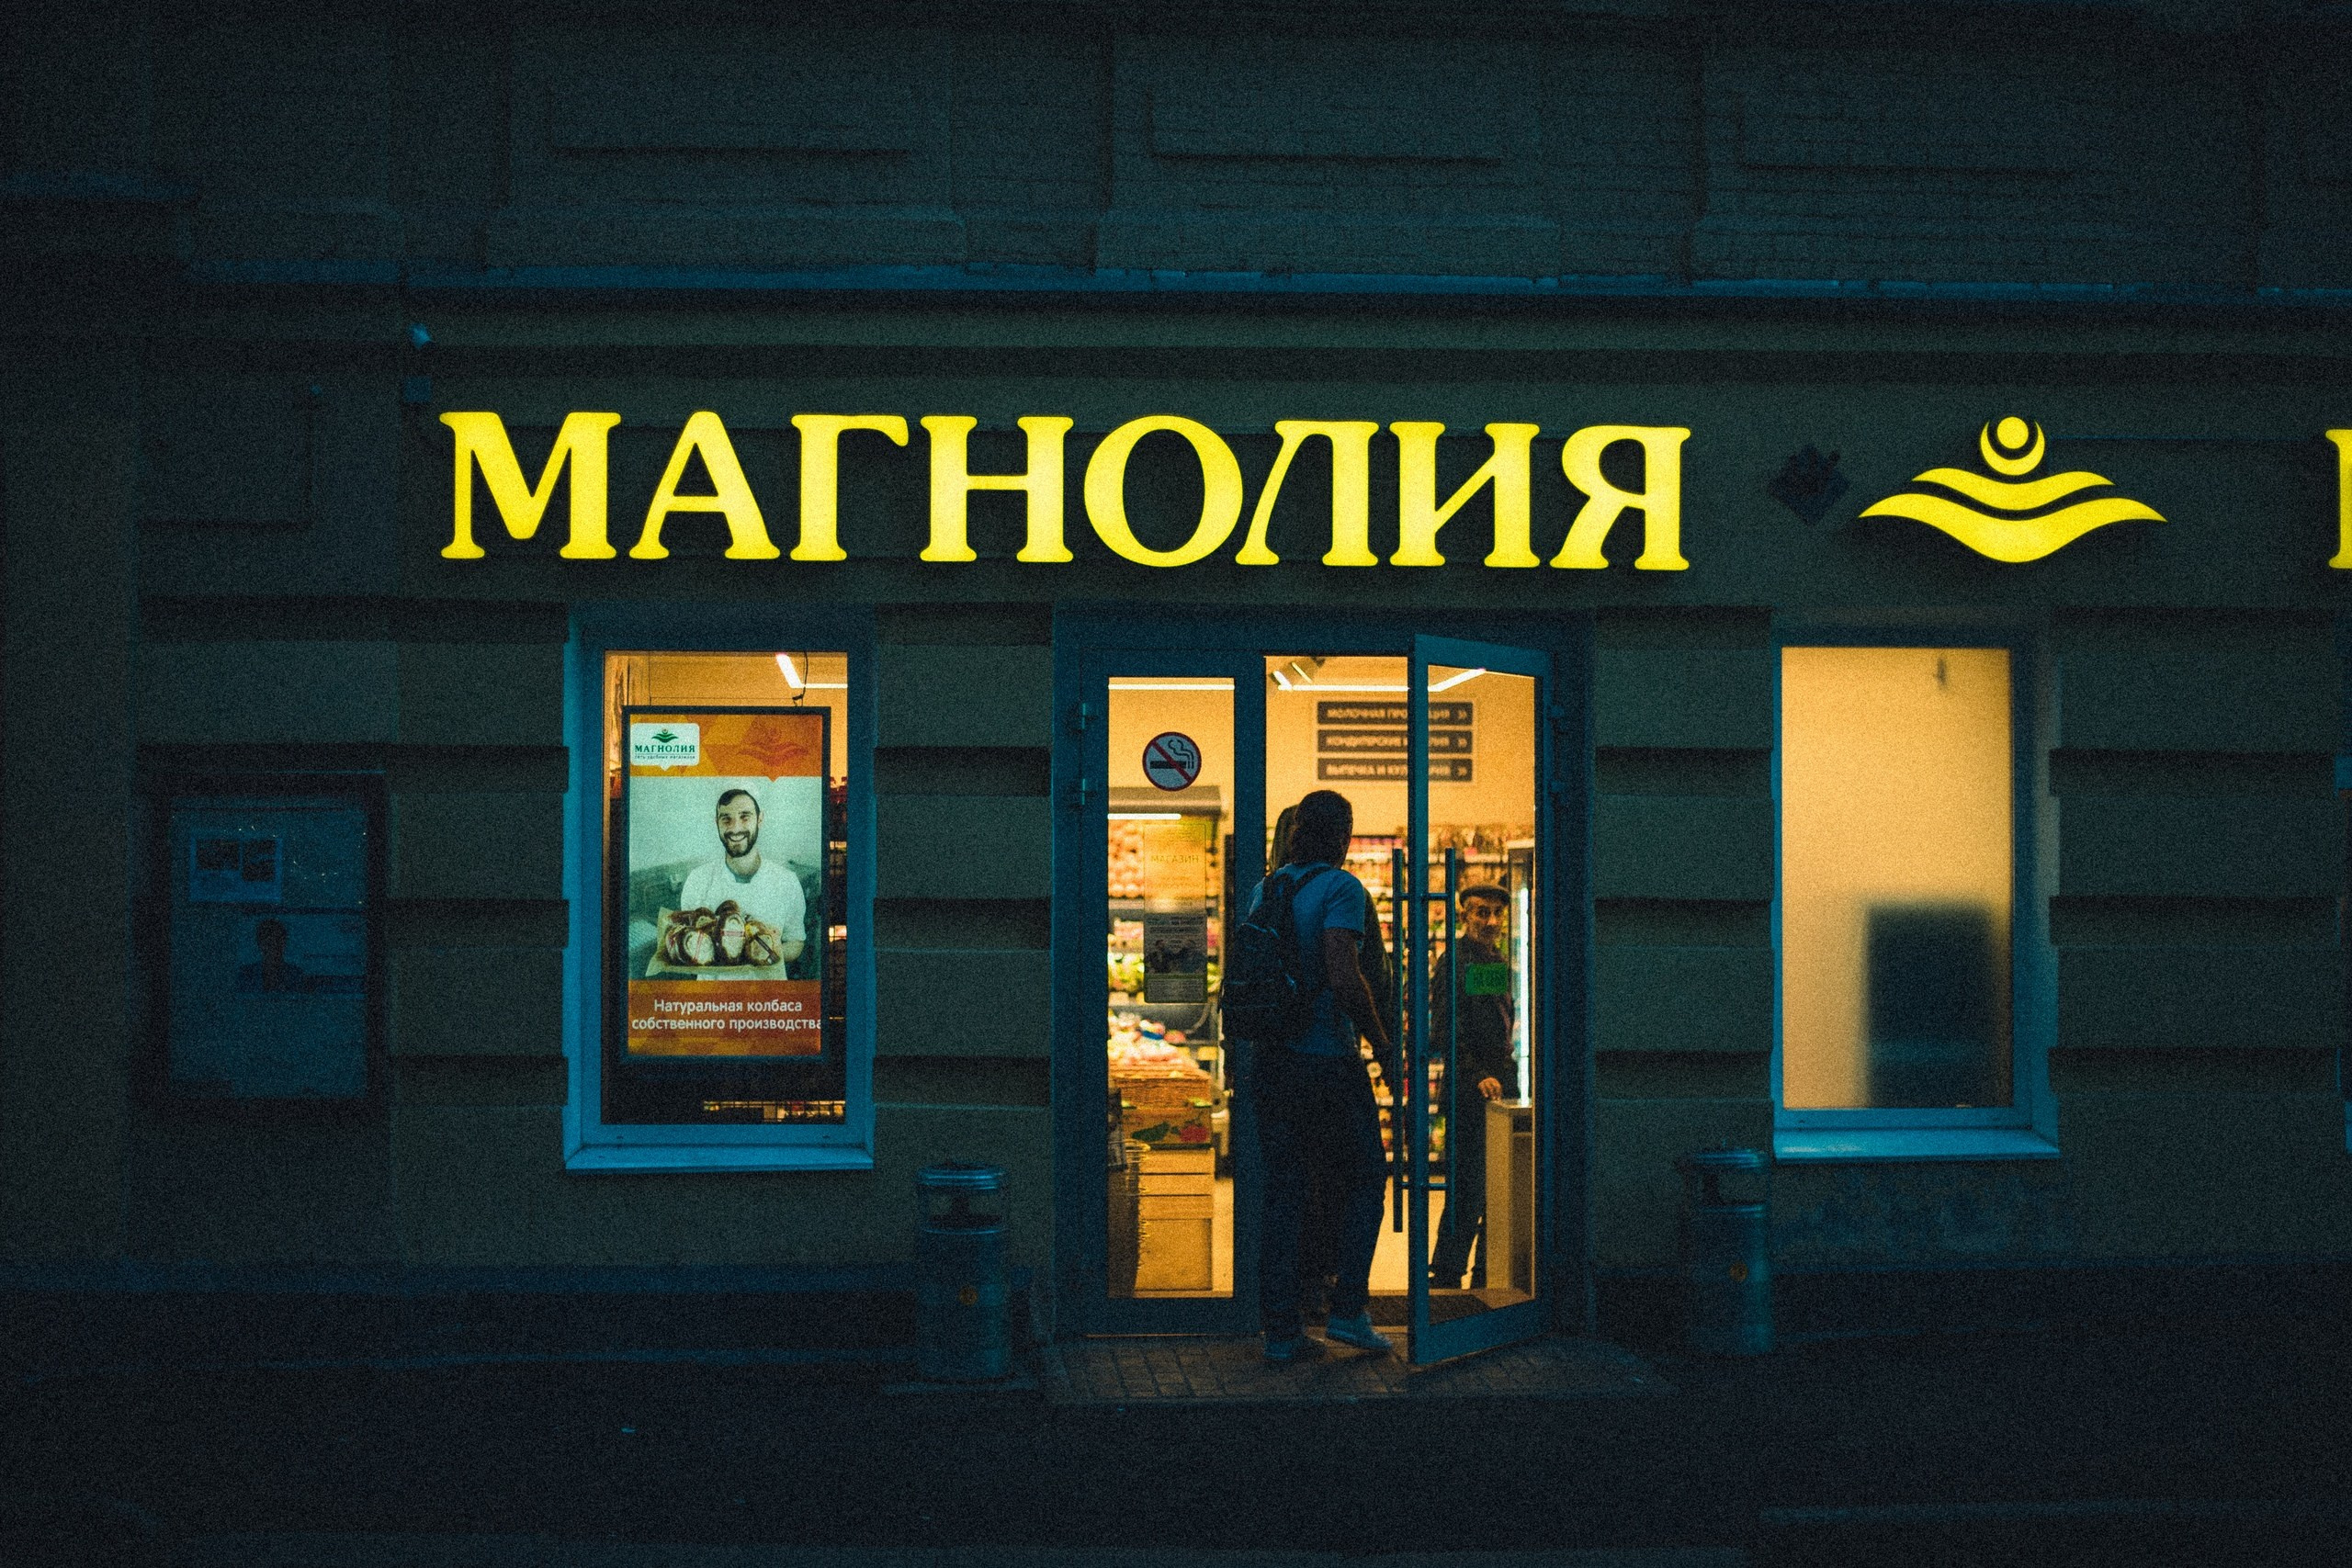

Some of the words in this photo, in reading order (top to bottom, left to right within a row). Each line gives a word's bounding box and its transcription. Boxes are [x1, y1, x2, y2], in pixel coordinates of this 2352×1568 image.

[439, 410, 1691, 571] МАГНОЛИЯ
[634, 744, 695, 753] МАГНОЛИЯ
[1150, 854, 1199, 863] МАГАЗИН
[653, 998, 743, 1015] Натуральная
[747, 998, 802, 1012] колбаса
[631, 1017, 726, 1031] собственного
